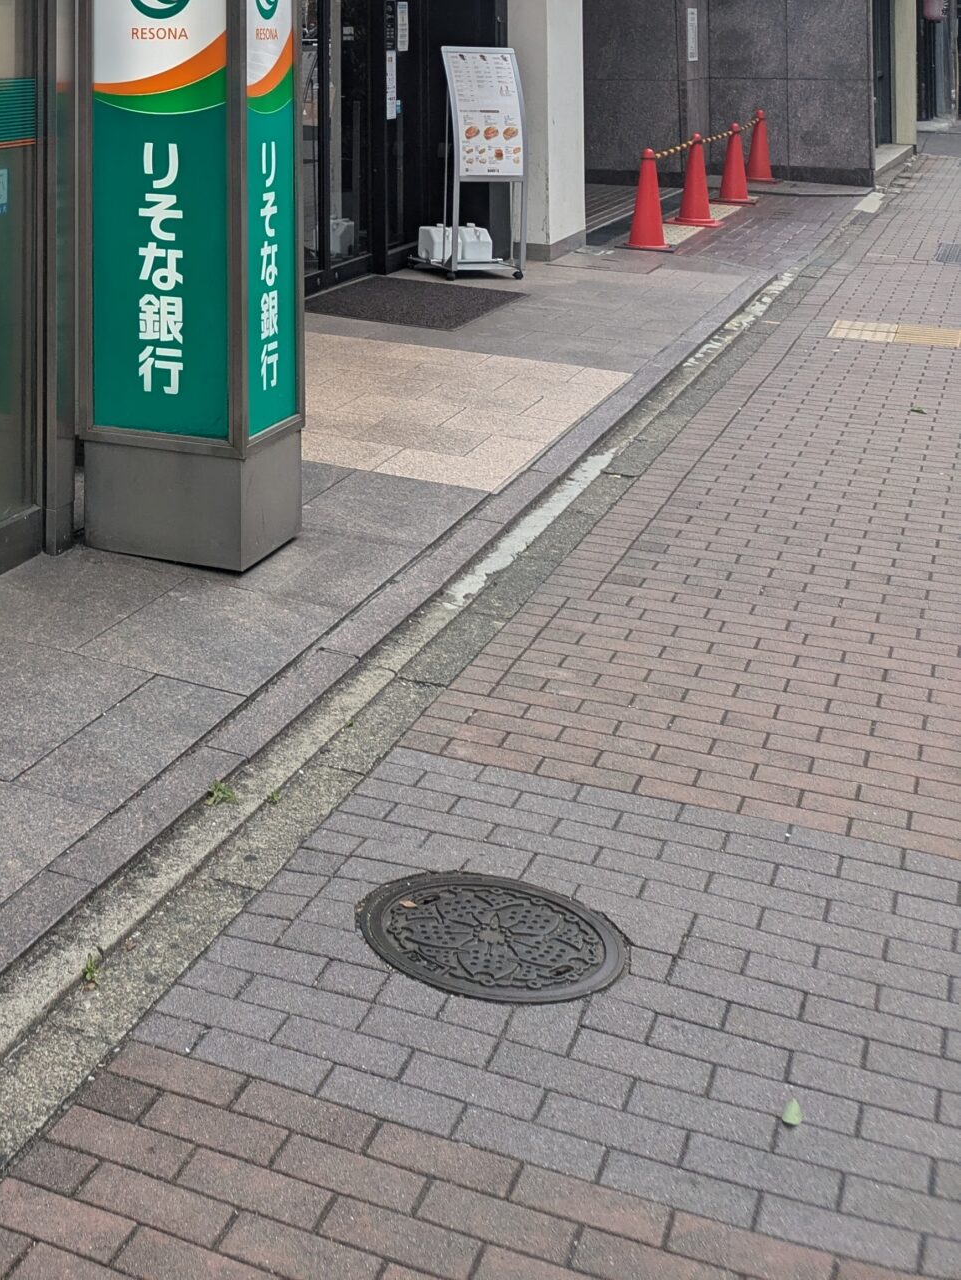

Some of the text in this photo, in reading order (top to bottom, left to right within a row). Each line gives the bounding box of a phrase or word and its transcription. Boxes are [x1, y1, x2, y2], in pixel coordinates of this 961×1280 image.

[131, 27, 188, 40] RESONA
[255, 28, 278, 41] RESONA
[138, 142, 184, 395] りそな銀行
[260, 141, 279, 391] りそな銀行
